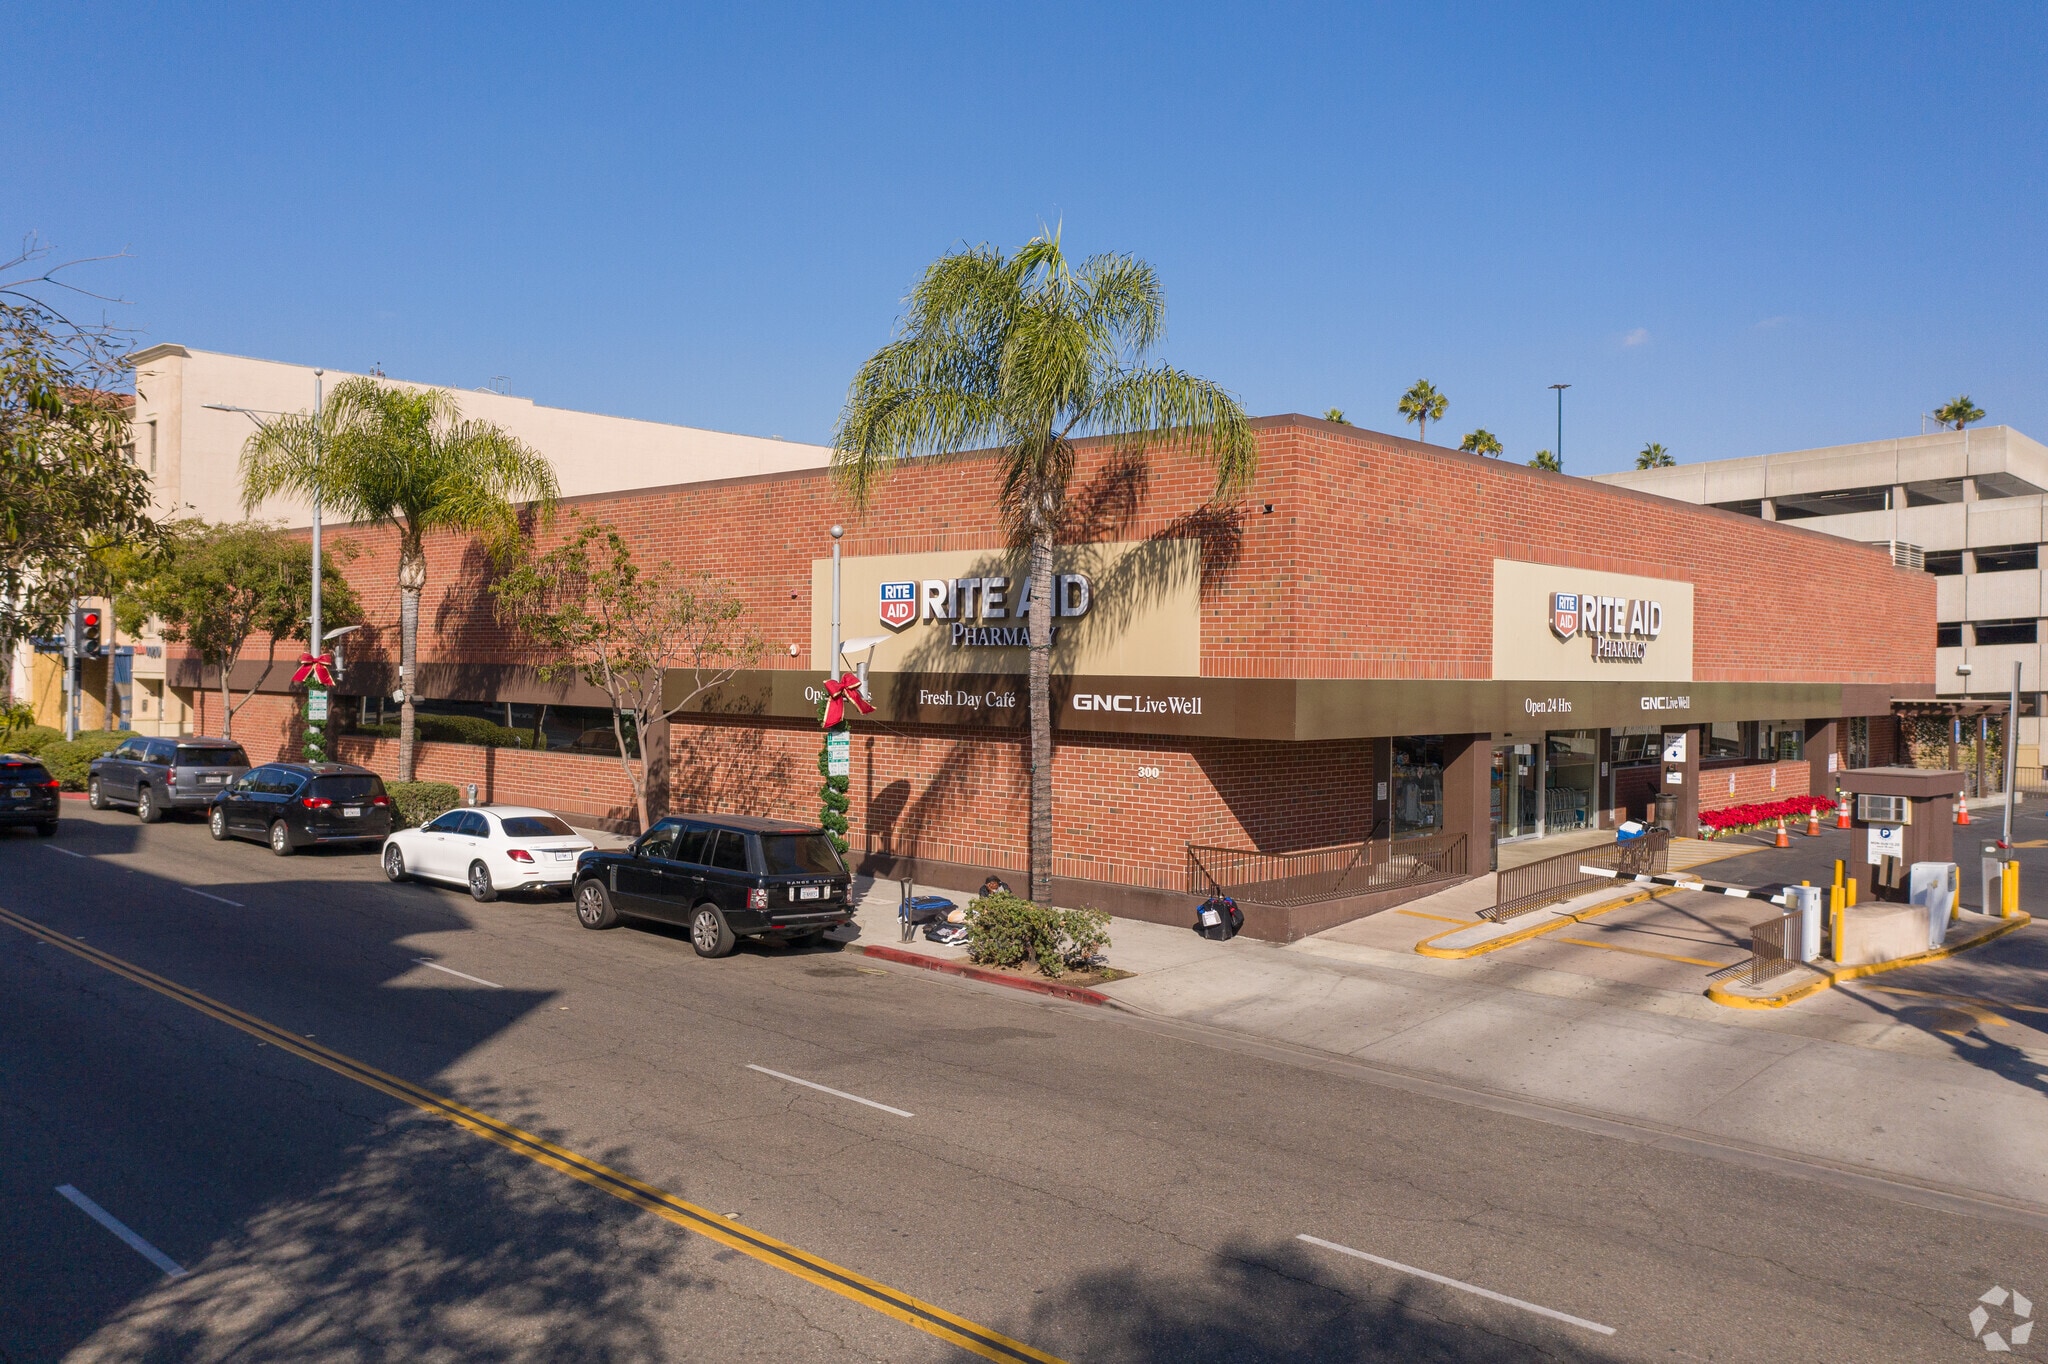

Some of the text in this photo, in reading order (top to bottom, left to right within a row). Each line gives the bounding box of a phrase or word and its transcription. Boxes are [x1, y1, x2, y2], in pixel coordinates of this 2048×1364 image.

[885, 585, 910, 599] RITE
[922, 577, 1006, 619] RITE
[886, 603, 909, 618] AID
[1558, 596, 1575, 610] RITE
[1560, 614, 1574, 629] AID
[1581, 594, 1663, 635] RITE AID
[951, 622, 1056, 647] PHARMAY
[1597, 635, 1647, 658] PHARMACY
[920, 690, 1016, 711] Fresh Day Café
[1073, 694, 1203, 715] GNC Live Well
[1525, 698, 1572, 716] Open 24 Hrs
[1640, 697, 1665, 710] GNC
[1138, 766, 1159, 778] 300
